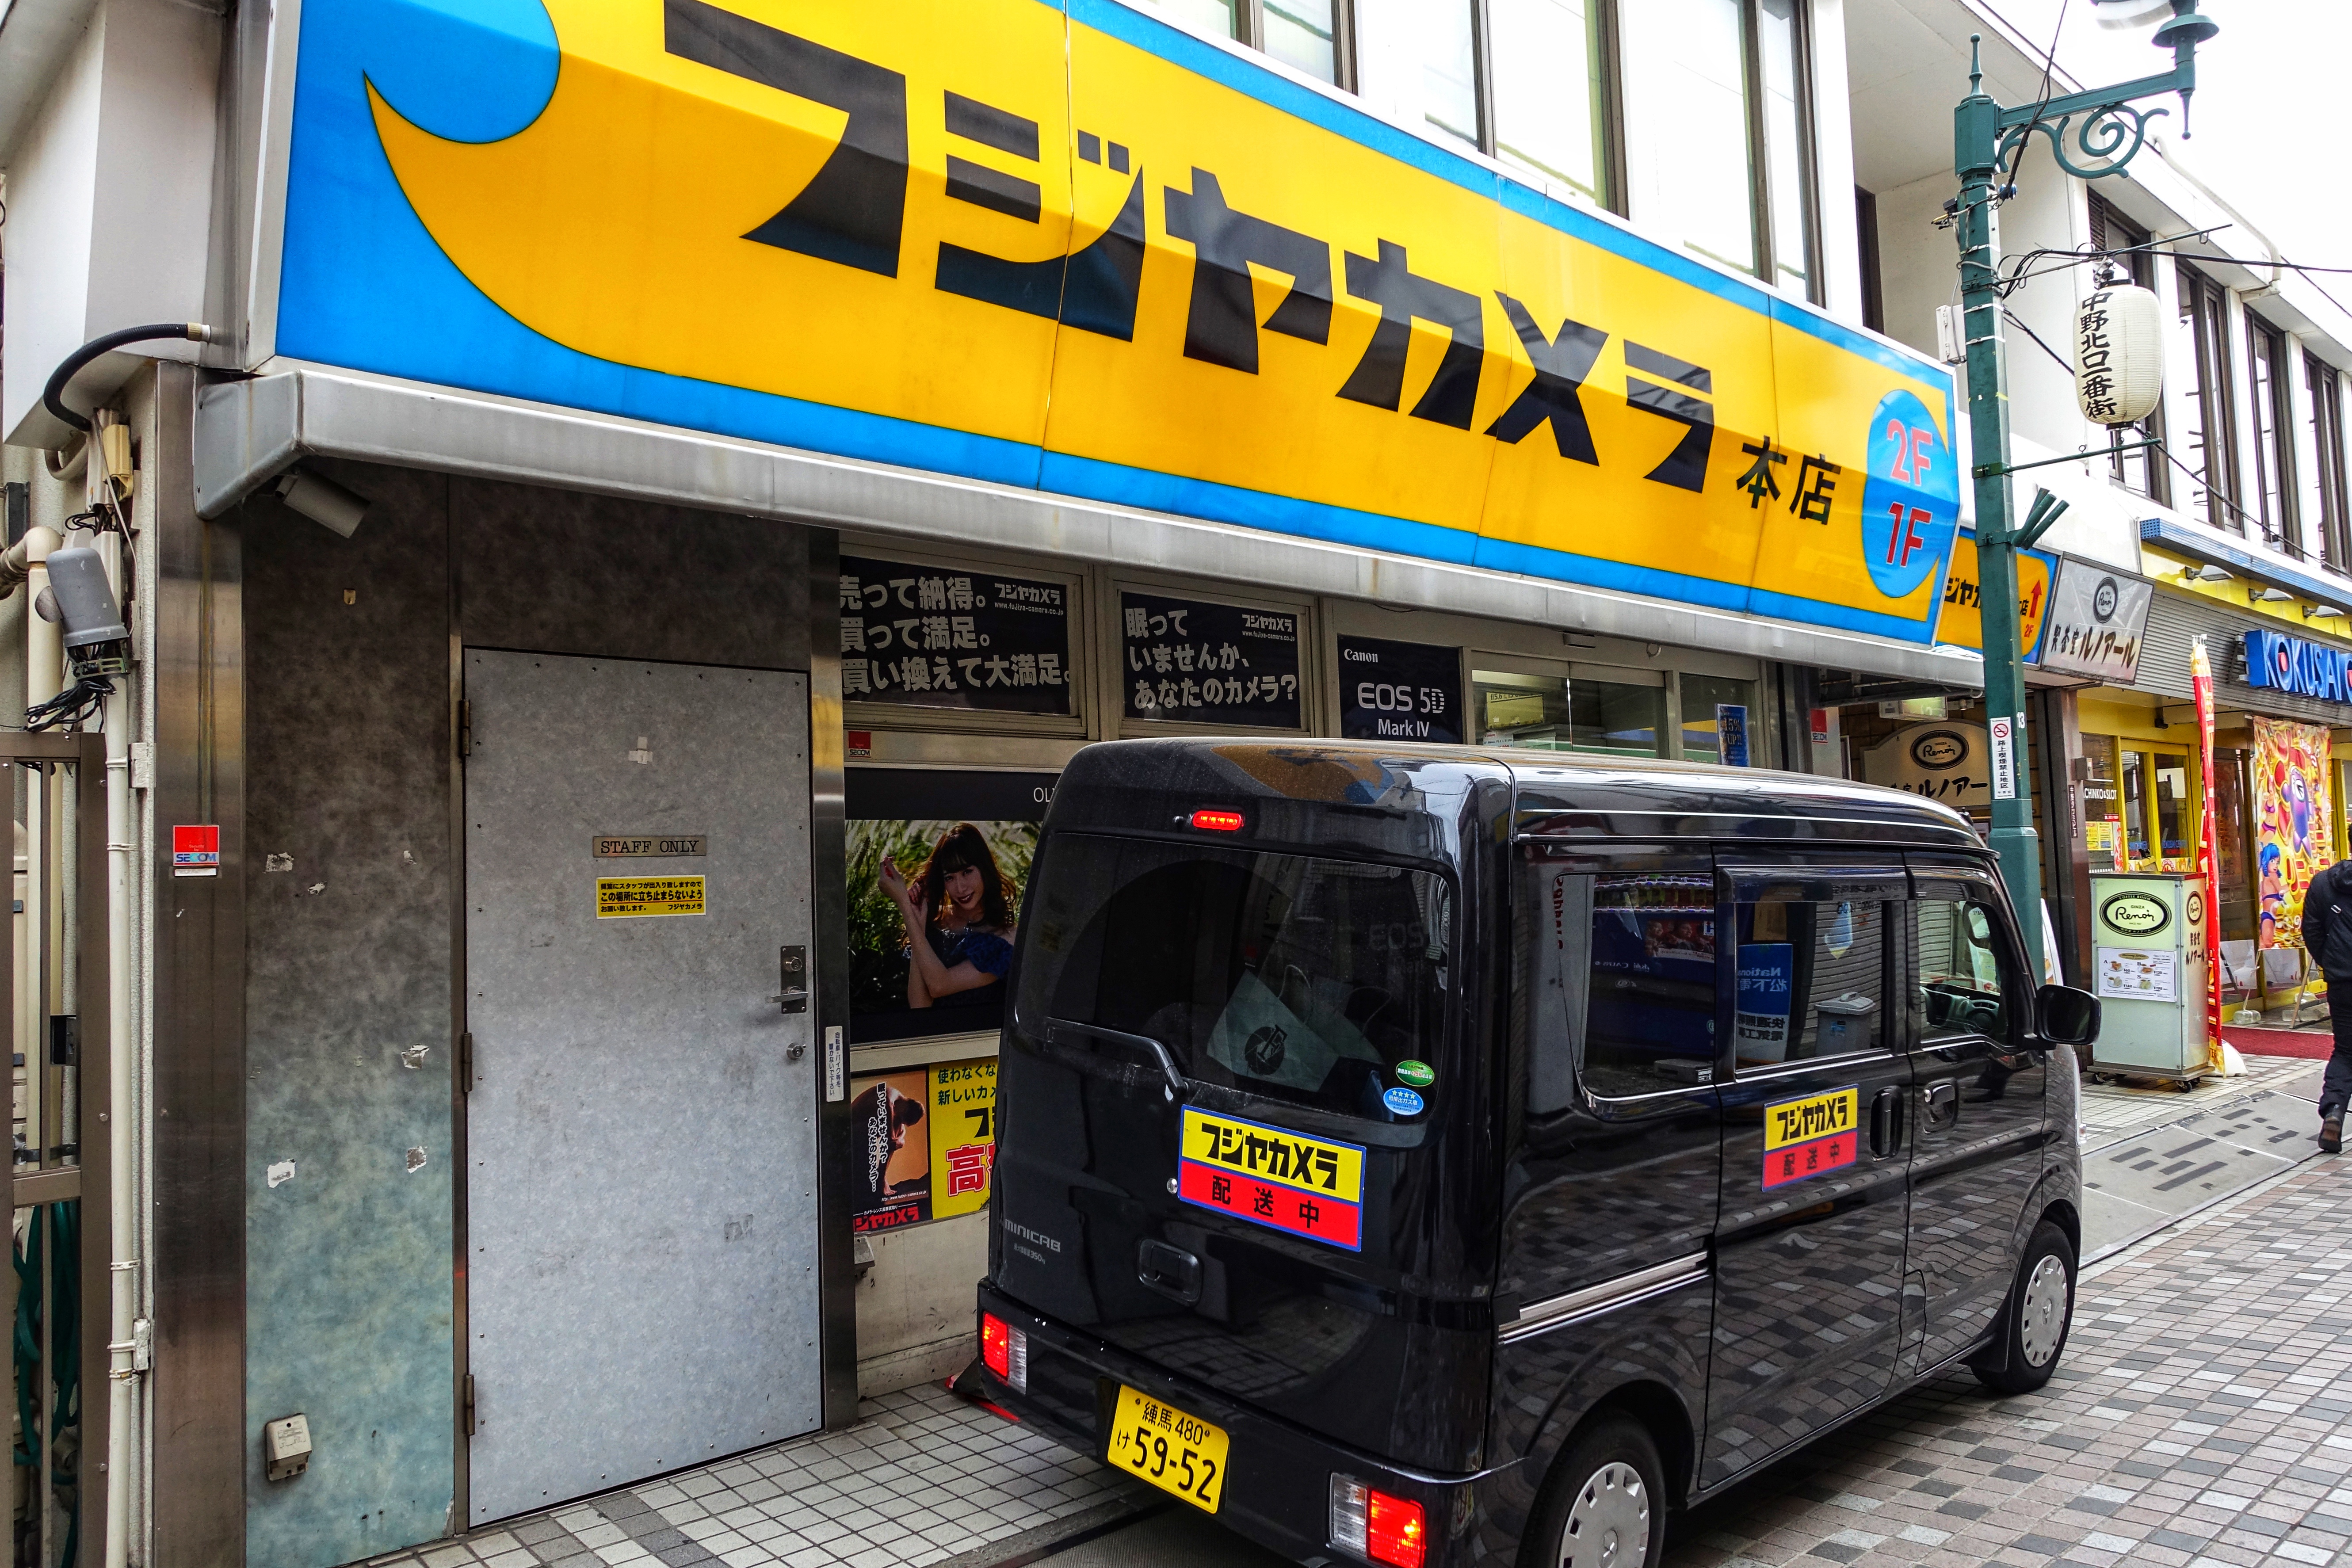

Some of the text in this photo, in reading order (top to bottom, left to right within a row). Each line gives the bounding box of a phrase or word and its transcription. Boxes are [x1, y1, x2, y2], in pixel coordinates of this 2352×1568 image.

[664, 0, 1714, 493] フジヤカメラ
[2080, 291, 2117, 419] 中野北口一番街
[1886, 418, 1933, 486] 2F
[1736, 435, 1841, 525] 本店
[1886, 501, 1932, 568] 1F
[840, 575, 986, 611] 売って納得。
[994, 583, 1060, 605] フジヤカメラ
[840, 615, 990, 652] 買って満足。
[1125, 607, 1188, 638] 眠って
[1242, 614, 1292, 632] フジヤカメラ
[2024, 623, 2034, 638] 2F
[1130, 642, 1250, 672] いませんか、
[1344, 648, 1378, 663] Canon
[2258, 629, 2343, 701] KOKUSAI
[1358, 682, 1445, 713] EOS 5D
[1378, 718, 1430, 738] Mark IV
[2016, 712, 2025, 729] 13
[1923, 744, 1956, 758] Renoir
[1997, 740, 2008, 789] 路上喫煙禁止地区
[2083, 787, 2117, 800] CHINKO&SLOT
[176, 853, 216, 862] SECOM
[600, 840, 699, 854] STAFF ONLY
[601, 889, 703, 902] この場所に立ち止まらないよう
[2115, 906, 2155, 922] Renoir
[938, 1063, 996, 1084] 使わなくな
[1388, 1095, 1418, 1106] 低排出ガス車
[965, 1106, 995, 1138] フ
[1777, 1095, 1848, 1142] フジヤカメラ
[1201, 1122, 1338, 1190] フジヤカメラ
[853, 1206, 919, 1232] ジヤカメラ
[1004, 1218, 1061, 1252] MINICAB
[1142, 1401, 1203, 1446] 練馬 480
[1117, 1426, 1216, 1504] け 59-52
